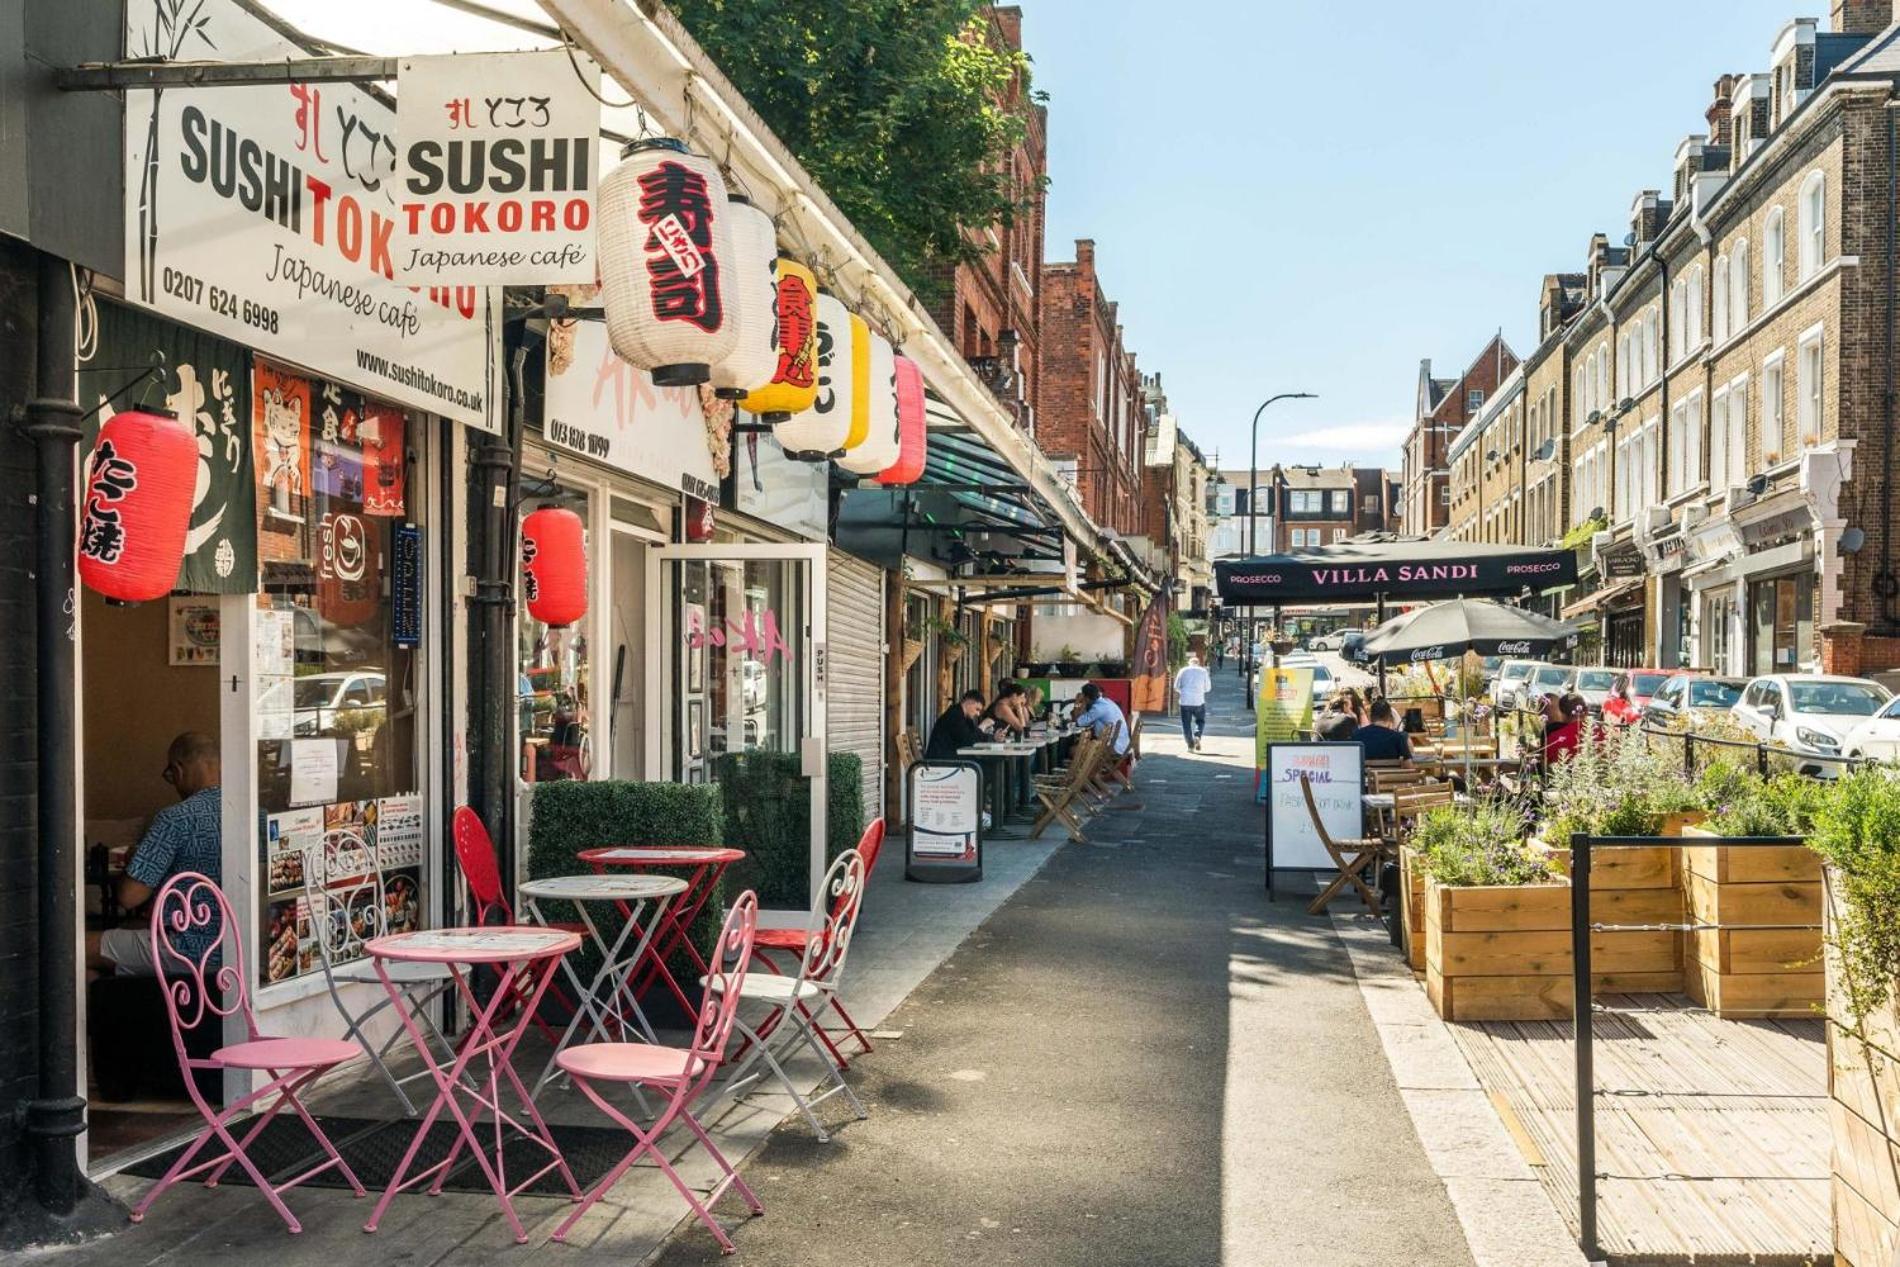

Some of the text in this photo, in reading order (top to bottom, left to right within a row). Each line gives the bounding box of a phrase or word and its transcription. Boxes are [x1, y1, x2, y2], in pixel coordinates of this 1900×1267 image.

[181, 105, 301, 235] SUSHI
[406, 137, 590, 195] SUSHI
[402, 198, 590, 235] TOKORO
[266, 243, 421, 340] Japanese café
[403, 243, 587, 273] Japanese café
[163, 266, 280, 335] 0207 624 6998
[356, 348, 483, 415] www.sushitokoro.co.uk
[212, 367, 241, 474] にぎり
[320, 512, 334, 579] fresh
[1229, 562, 1562, 585] PROSECCO VILLA SANDI PROSECCO
[816, 649, 824, 682] PUSH
